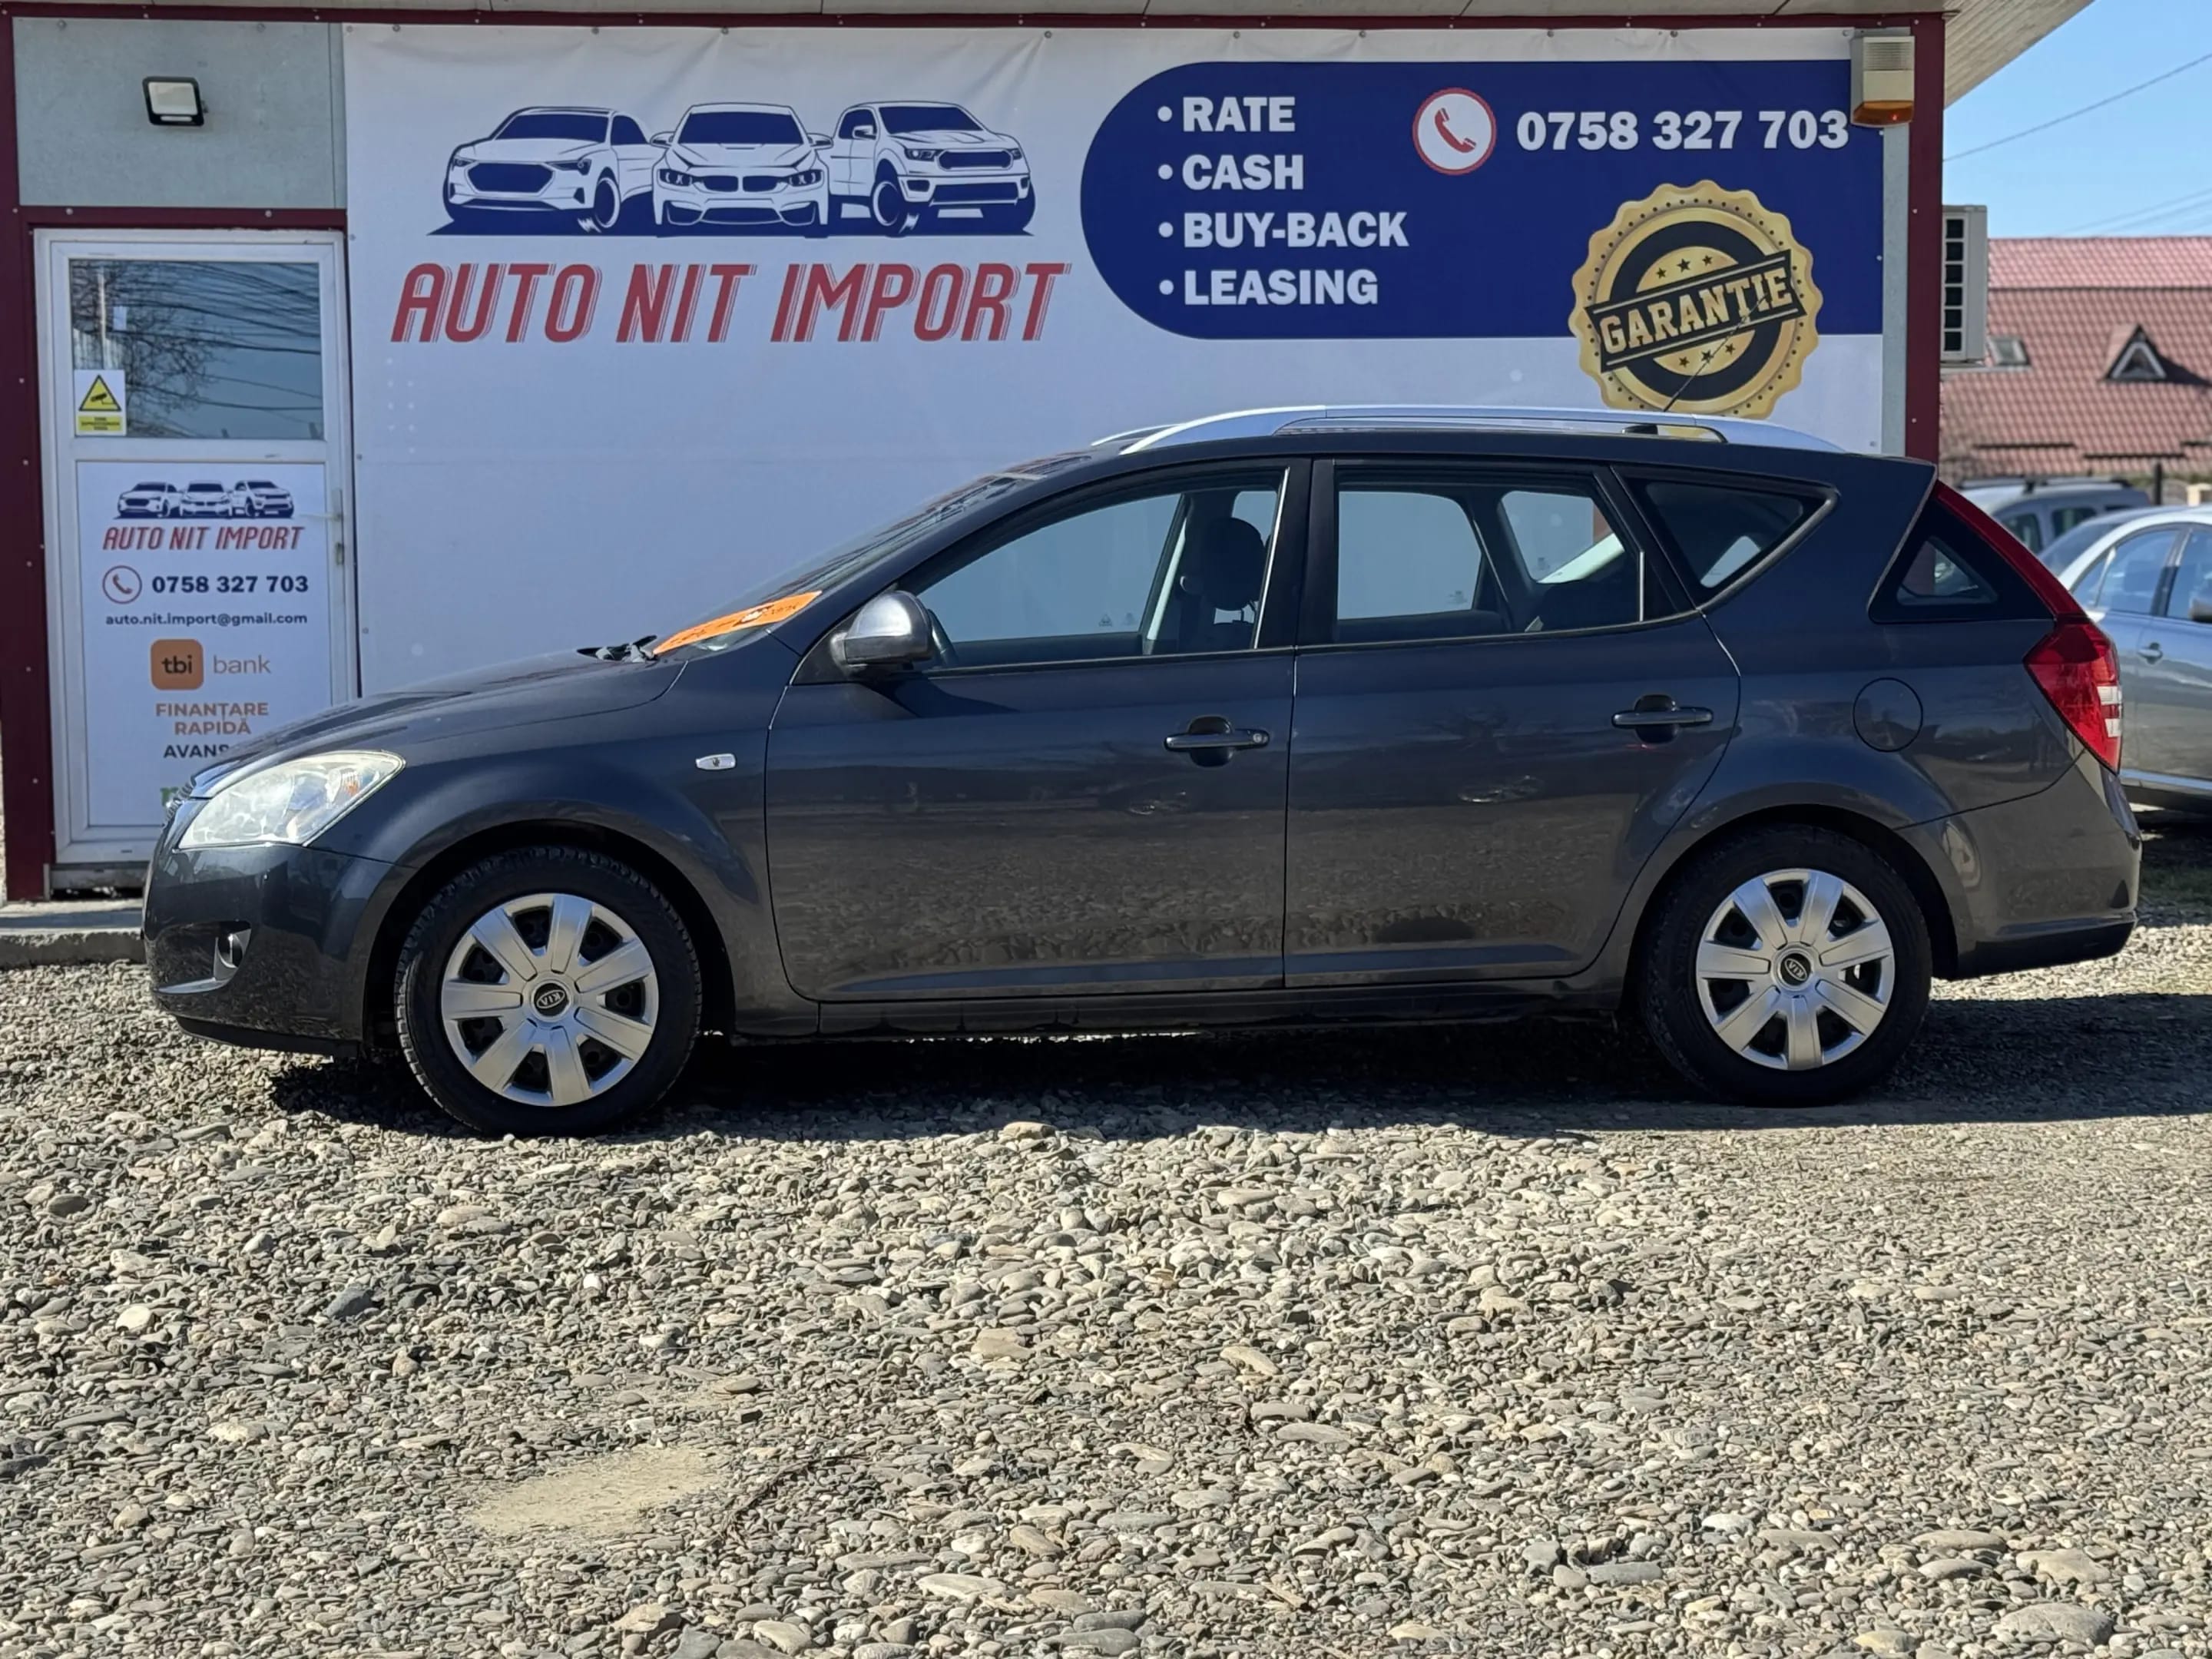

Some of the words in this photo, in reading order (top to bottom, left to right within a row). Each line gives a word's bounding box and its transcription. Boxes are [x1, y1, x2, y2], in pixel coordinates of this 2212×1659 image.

[1183, 96, 1296, 132] RATE
[1517, 111, 1639, 151] 0758
[1652, 111, 1743, 150] 327
[1759, 110, 1849, 149] 703
[1182, 154, 1303, 190] CASH
[1184, 211, 1409, 248] BUY-BACK
[390, 263, 603, 343] AUTO
[615, 263, 759, 343] NIT
[770, 262, 1072, 343] IMPORT
[1184, 269, 1378, 305] LEASING
[102, 526, 165, 551] AUTO
[168, 526, 211, 551] NIT
[214, 525, 306, 551] IMPORT
[151, 575, 210, 594] 0758
[216, 575, 259, 594] 327
[266, 575, 309, 593] 703
[105, 611, 308, 627] auto.nit.import@gmail.com
[161, 654, 193, 675] tbi
[213, 654, 273, 675] bank
[538, 992, 563, 1007] KIA
